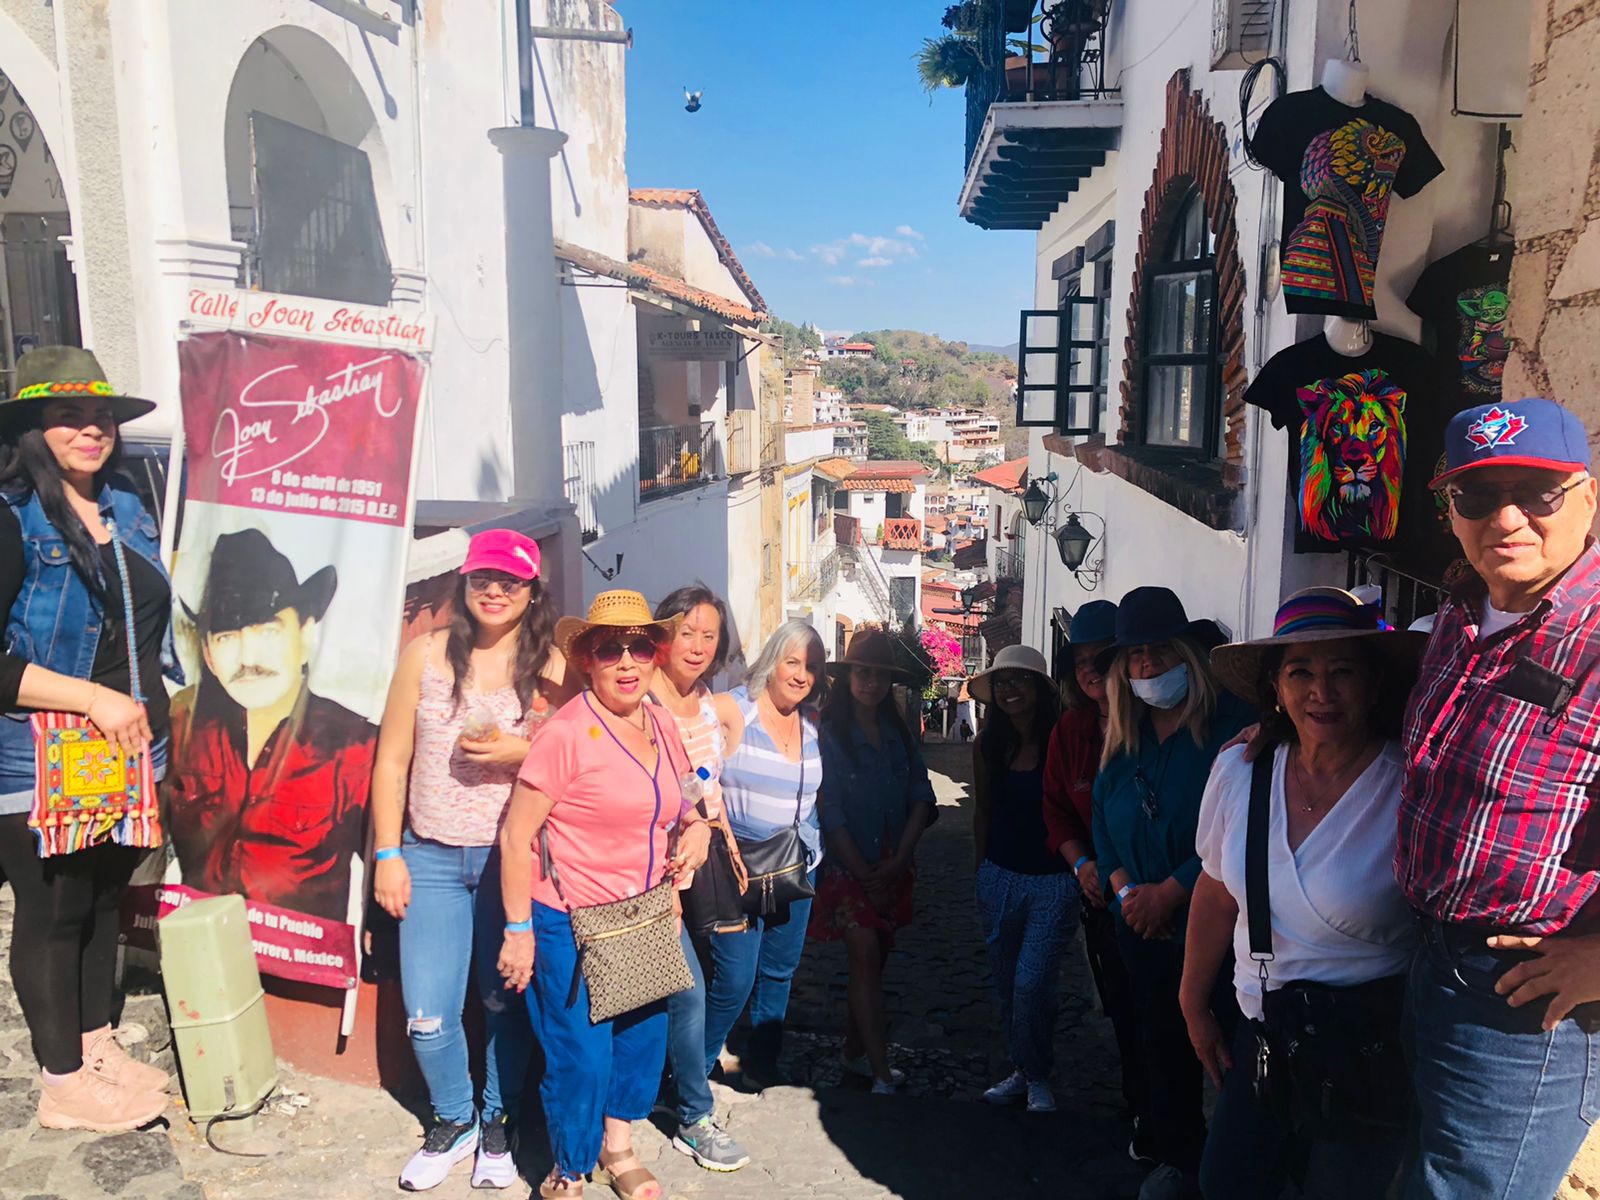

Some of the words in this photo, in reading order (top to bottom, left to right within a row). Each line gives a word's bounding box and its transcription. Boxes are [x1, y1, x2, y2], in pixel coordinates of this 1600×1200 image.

[248, 299, 315, 332] Joan
[324, 308, 425, 345] Sebastian
[704, 331, 733, 340] TAXCO
[211, 408, 278, 487] Joan
[271, 469, 281, 485] 8
[282, 471, 300, 487] de
[301, 474, 336, 491] abril
[336, 478, 350, 493] de
[351, 479, 382, 497] 1951
[250, 487, 266, 503] 13
[266, 489, 284, 505] de
[284, 491, 318, 509] julio
[319, 495, 338, 511] de
[248, 907, 263, 924] de
[265, 912, 278, 928] tu
[280, 914, 324, 939] Pueblo
[251, 939, 293, 963] errero,
[294, 948, 344, 968] México
